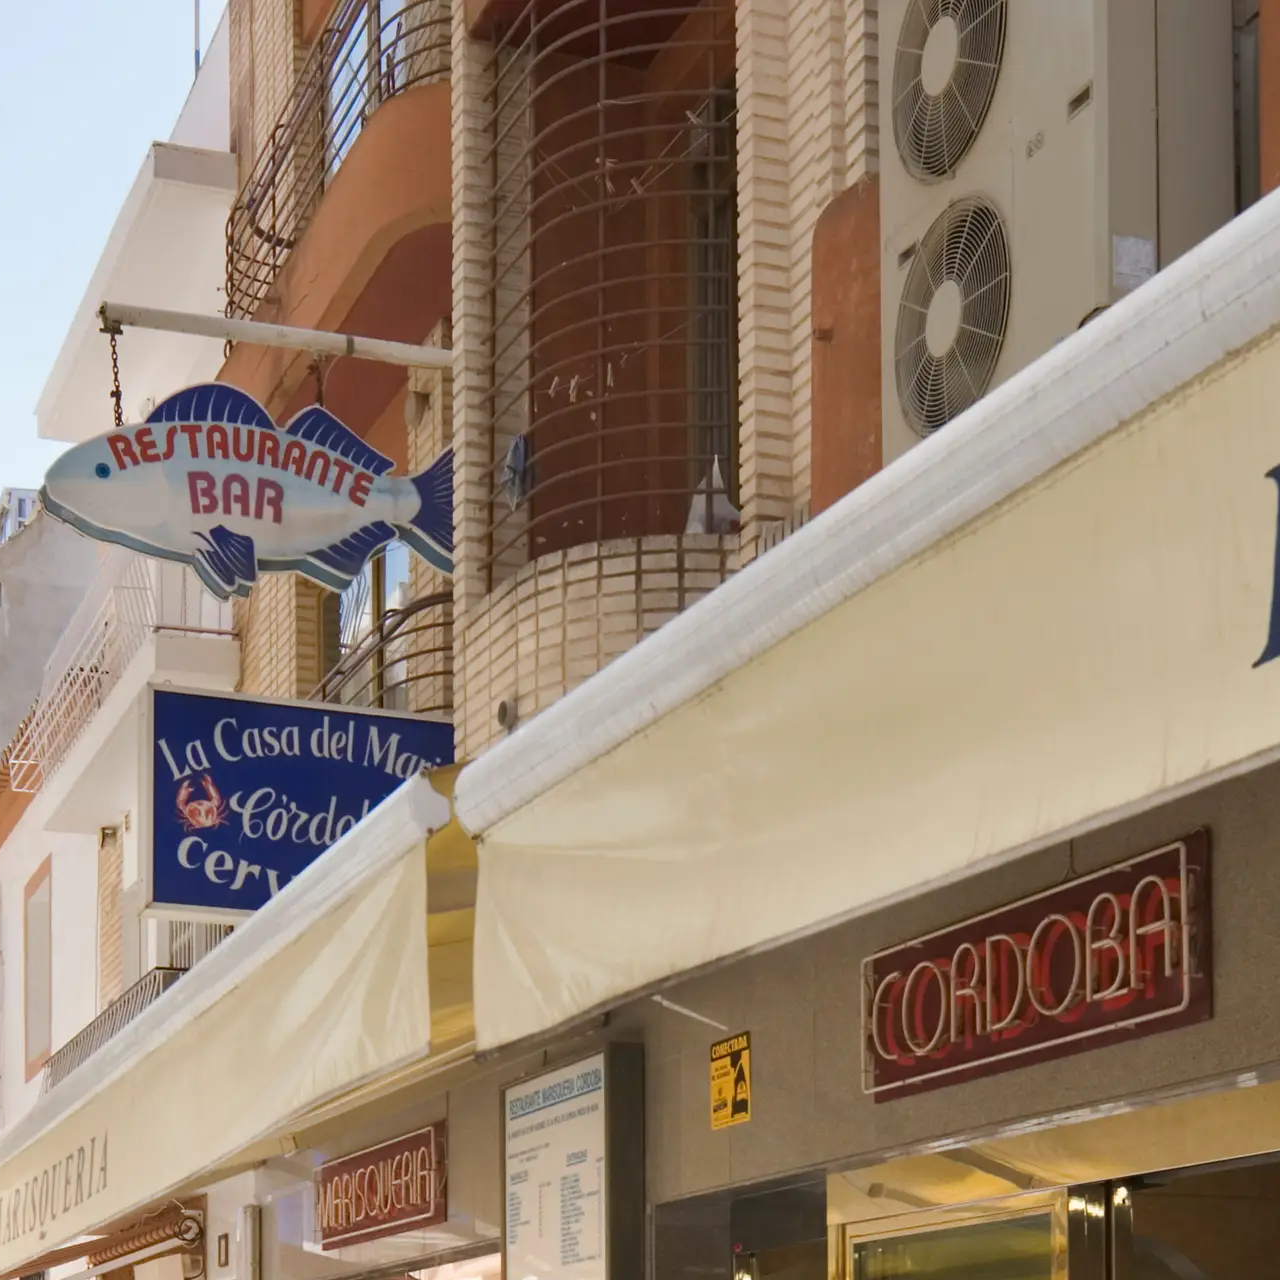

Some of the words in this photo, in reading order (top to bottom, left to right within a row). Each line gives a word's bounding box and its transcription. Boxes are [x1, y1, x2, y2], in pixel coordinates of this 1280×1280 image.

[106, 423, 375, 508] RESTAURANTE
[186, 470, 285, 525] BAR
[157, 737, 211, 782] La
[213, 717, 301, 762] Casa
[310, 715, 355, 763] del
[872, 874, 1175, 1061] CORDOBA
[711, 1034, 749, 1059] CONECTADA
[508, 1089, 542, 1117] RESTAURANTE
[542, 1076, 576, 1104] MARISQUERIA
[576, 1067, 603, 1093] CORDOBA
[317, 1146, 431, 1229] MARISQUERIA
